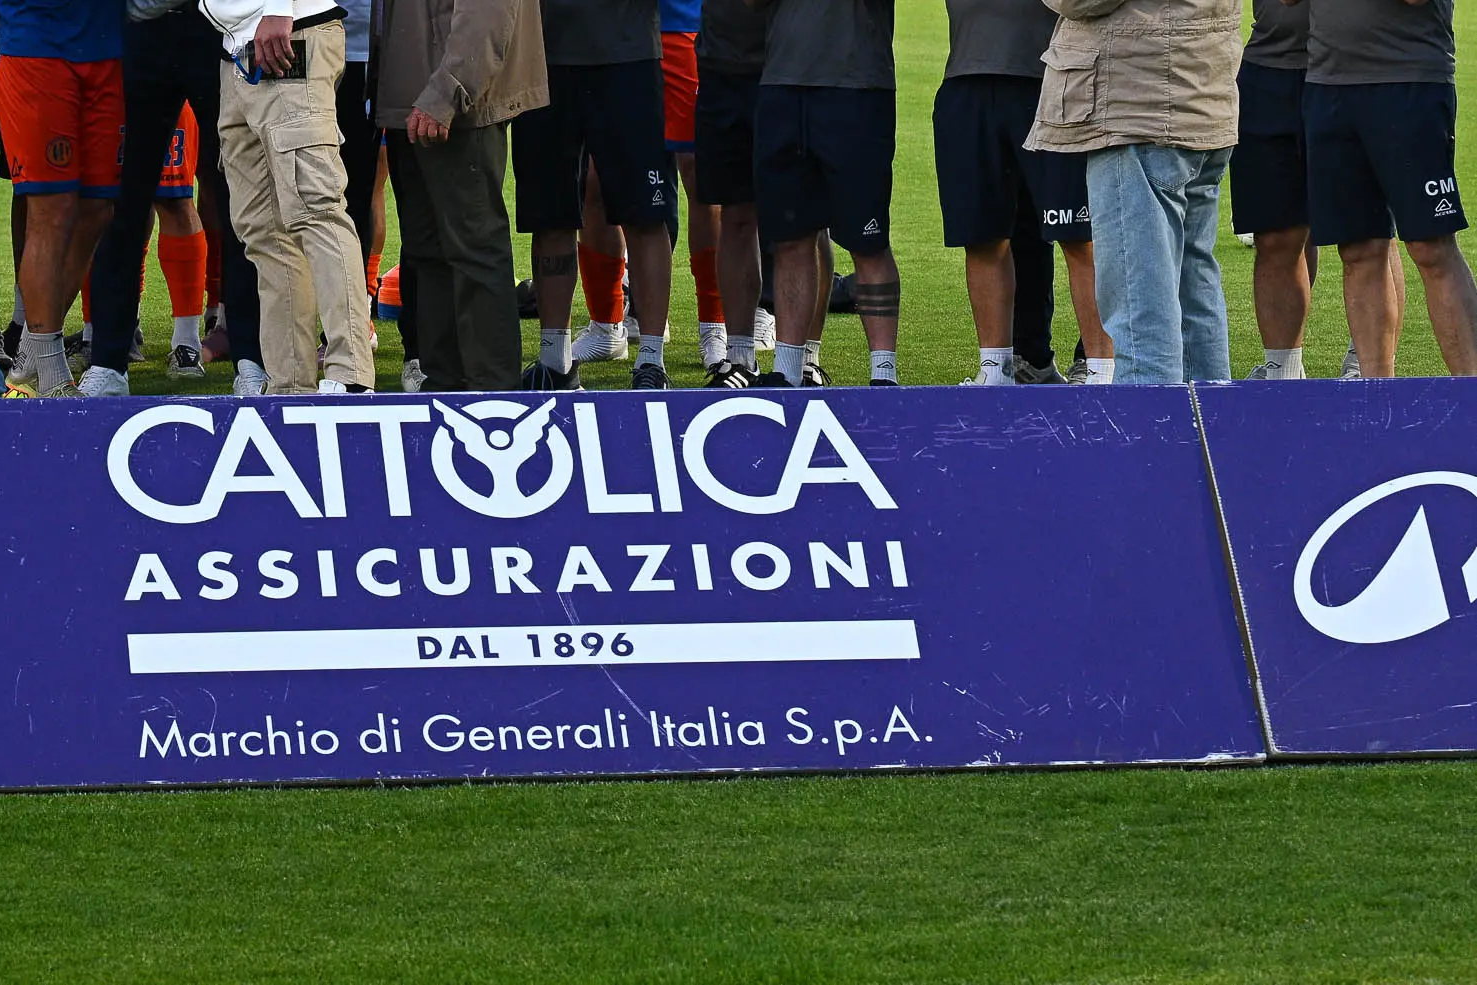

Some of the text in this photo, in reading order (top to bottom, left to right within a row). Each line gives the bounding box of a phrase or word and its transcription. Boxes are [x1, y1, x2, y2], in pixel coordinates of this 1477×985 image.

[648, 170, 664, 184] SL
[1425, 177, 1455, 196] CM
[107, 397, 899, 524] CATTOLICA
[124, 541, 909, 601] ASSICURAZIONI
[417, 632, 635, 660] DAL 1896
[140, 705, 934, 758] Marchio di Generali Italia S.p.A.
